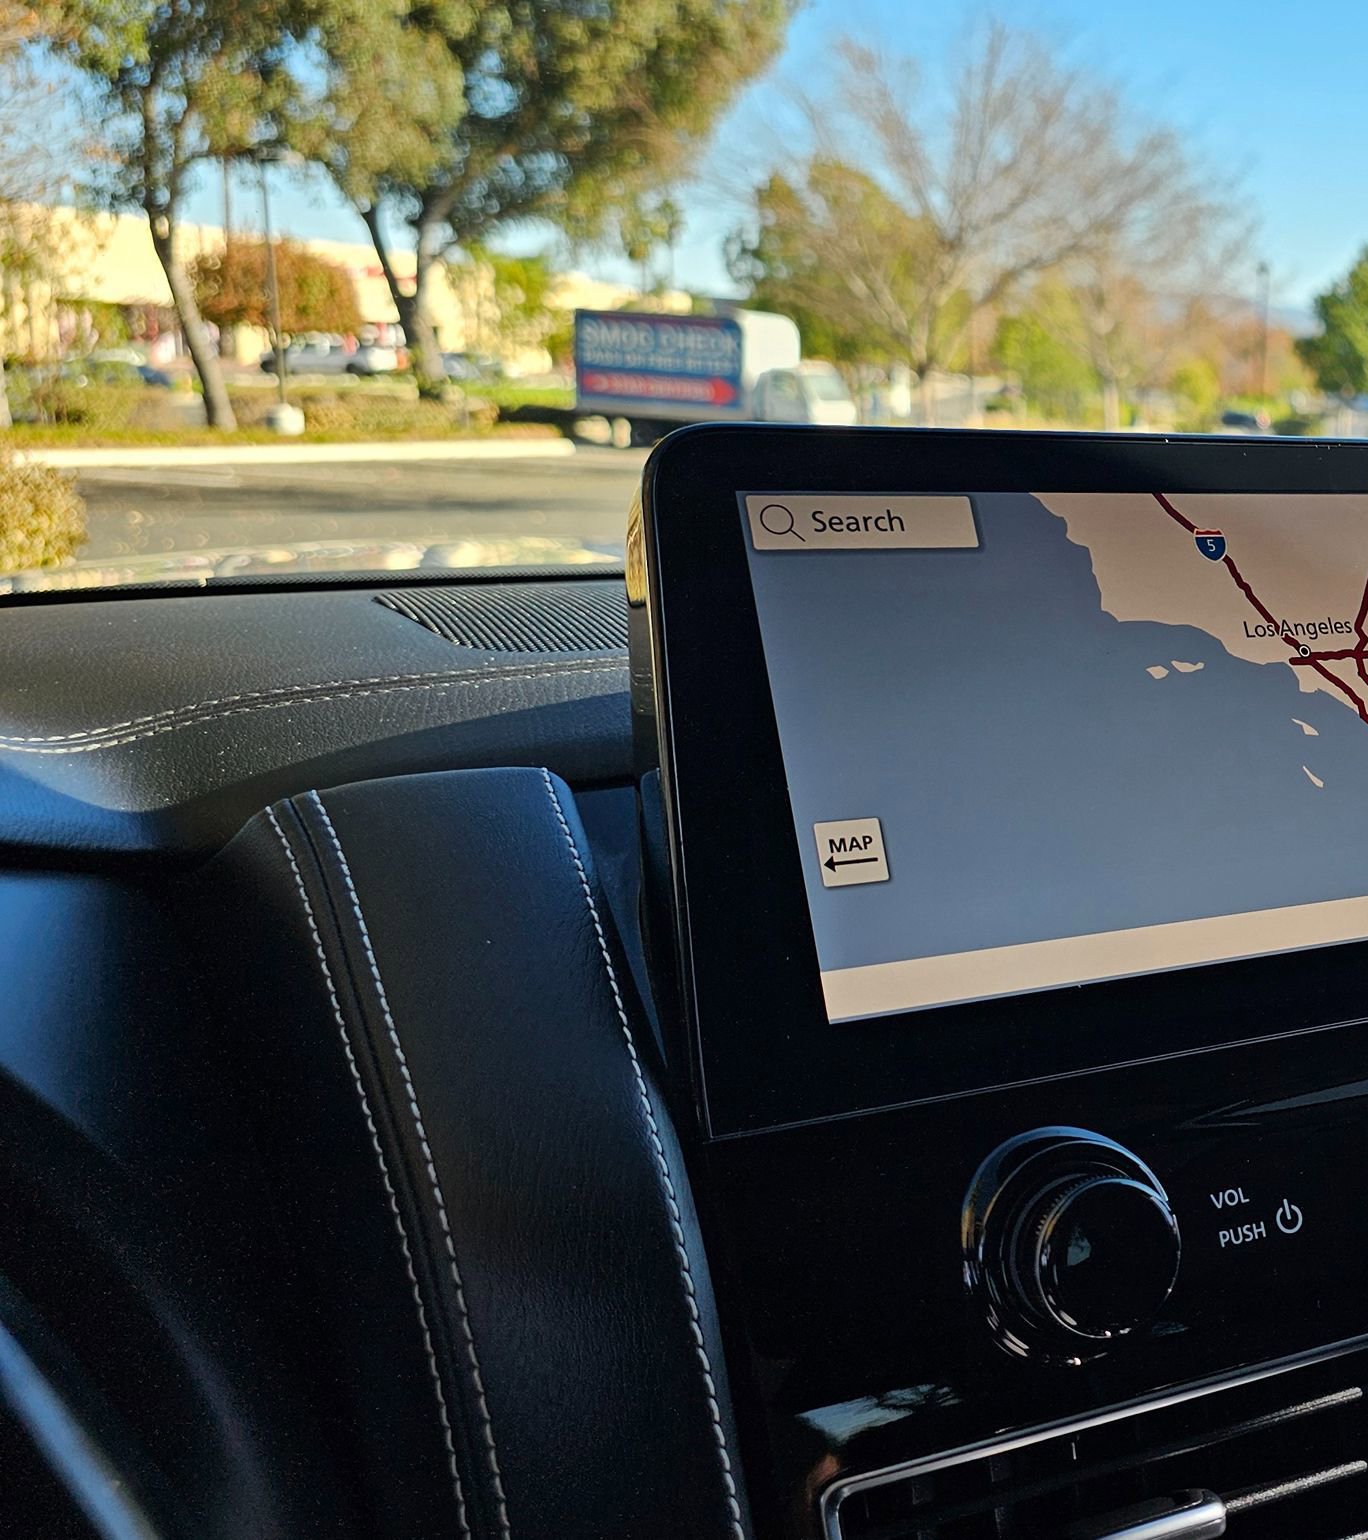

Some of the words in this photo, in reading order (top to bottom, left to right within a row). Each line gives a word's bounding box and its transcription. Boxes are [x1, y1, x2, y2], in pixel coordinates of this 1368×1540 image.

[811, 509, 905, 532] Search
[1206, 539, 1216, 552] 5
[1243, 620, 1276, 638] Los
[1280, 617, 1353, 639] Angeles
[828, 835, 874, 854] MAP
[1210, 1187, 1250, 1209] VOL
[1218, 1221, 1267, 1248] PUSH
